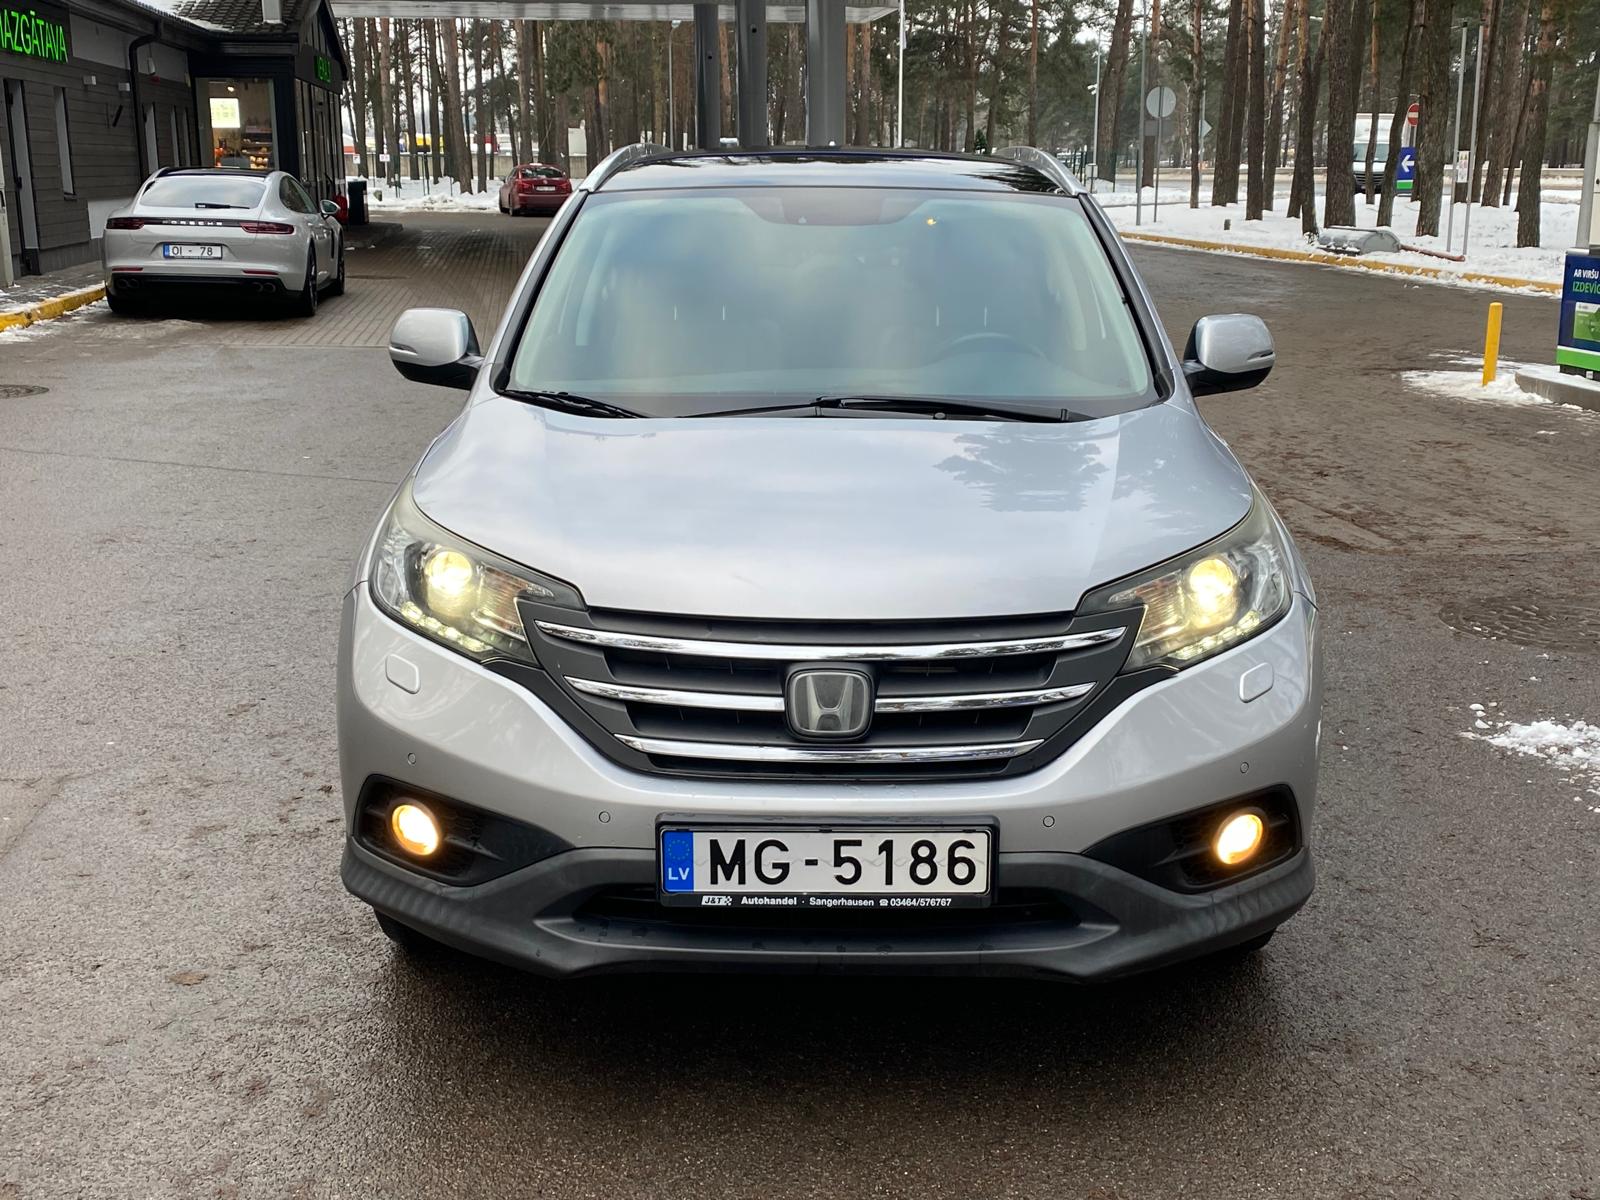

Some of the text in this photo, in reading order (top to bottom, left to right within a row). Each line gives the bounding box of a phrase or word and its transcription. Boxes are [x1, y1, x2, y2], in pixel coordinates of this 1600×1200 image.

[709, 839, 977, 886] MG-5186
[668, 867, 690, 880] LV
[741, 896, 797, 905] Autohandel
[809, 897, 875, 907] Sangerhausen
[890, 898, 952, 907] 03464/576767
